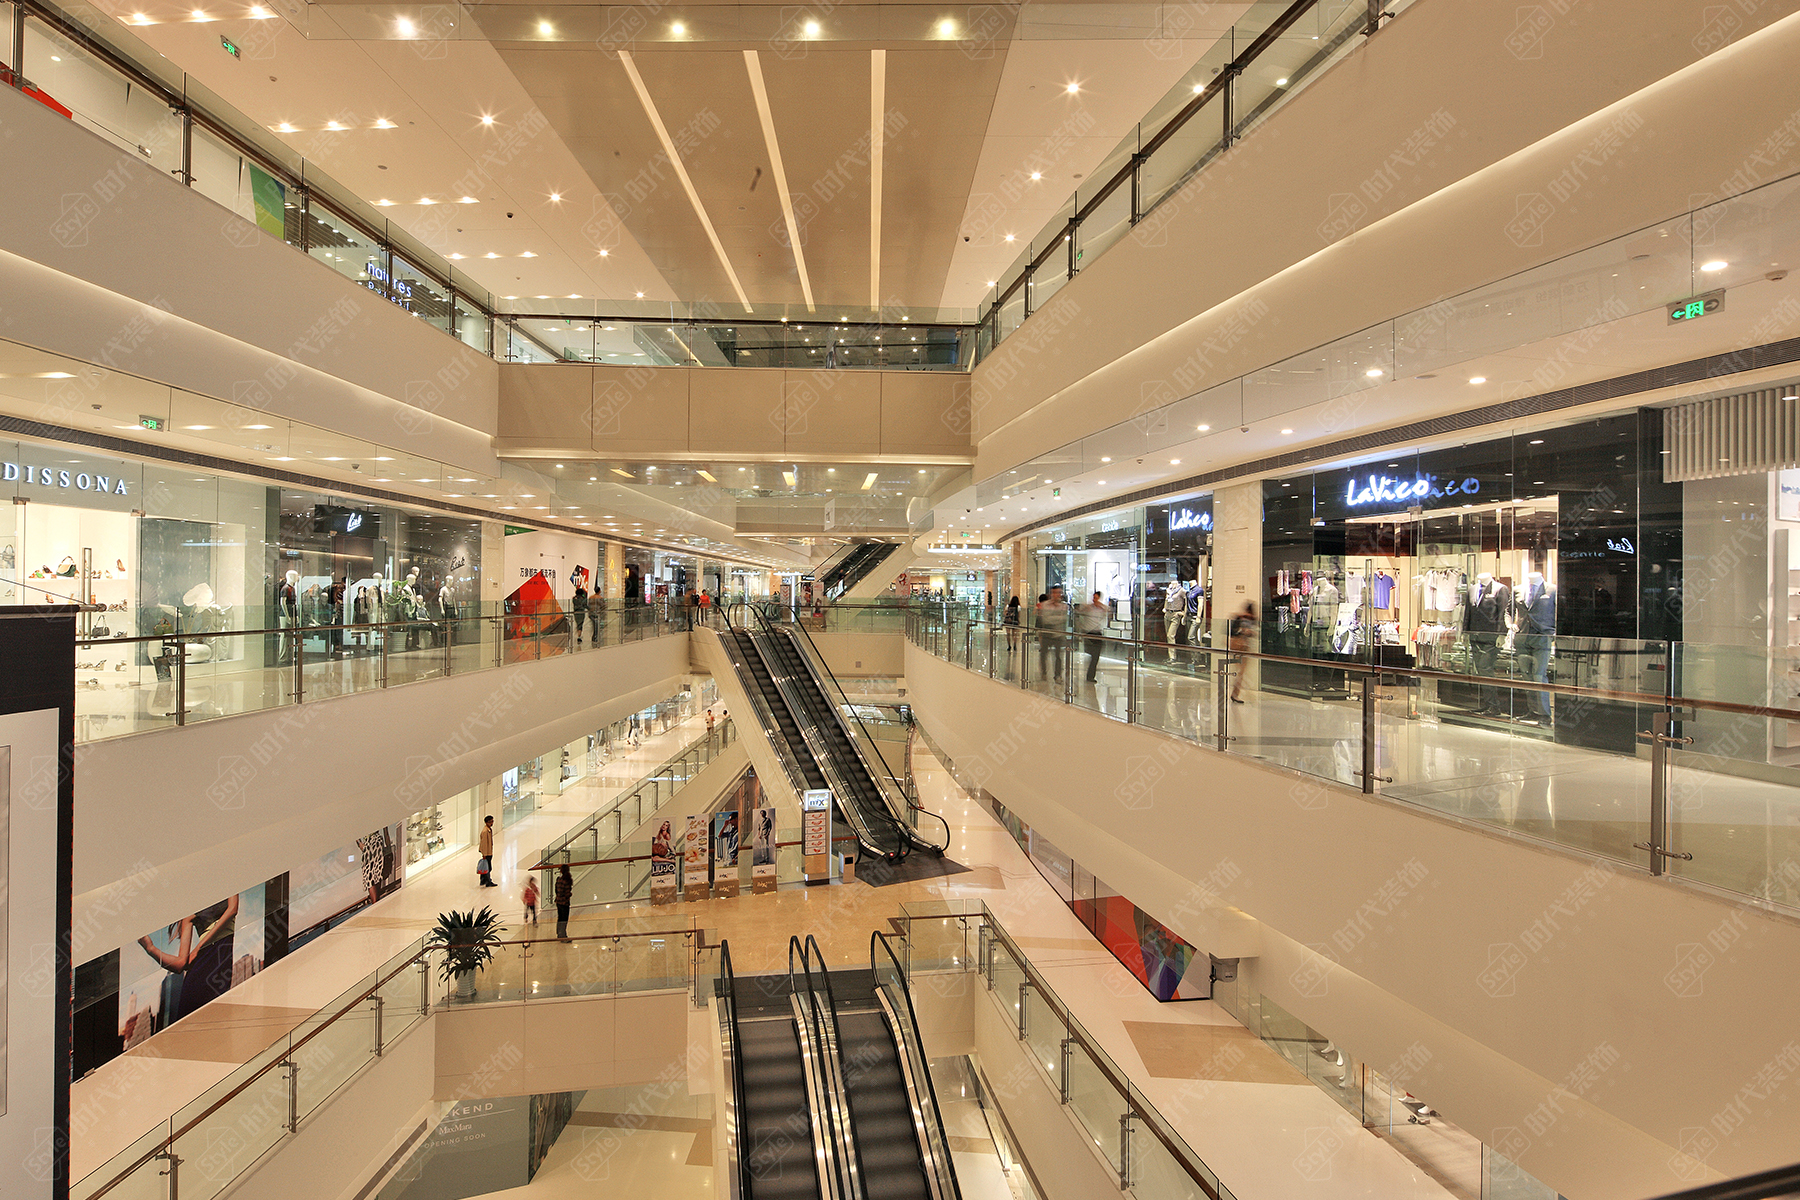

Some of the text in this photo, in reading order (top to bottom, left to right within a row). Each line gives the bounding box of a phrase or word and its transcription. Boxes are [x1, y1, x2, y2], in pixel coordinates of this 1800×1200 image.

[3, 462, 128, 495] DISSONA
[1346, 474, 1430, 506] LaVico
[424, 1133, 486, 1149] OPENING SOON
[439, 1123, 472, 1135] MaxMara
